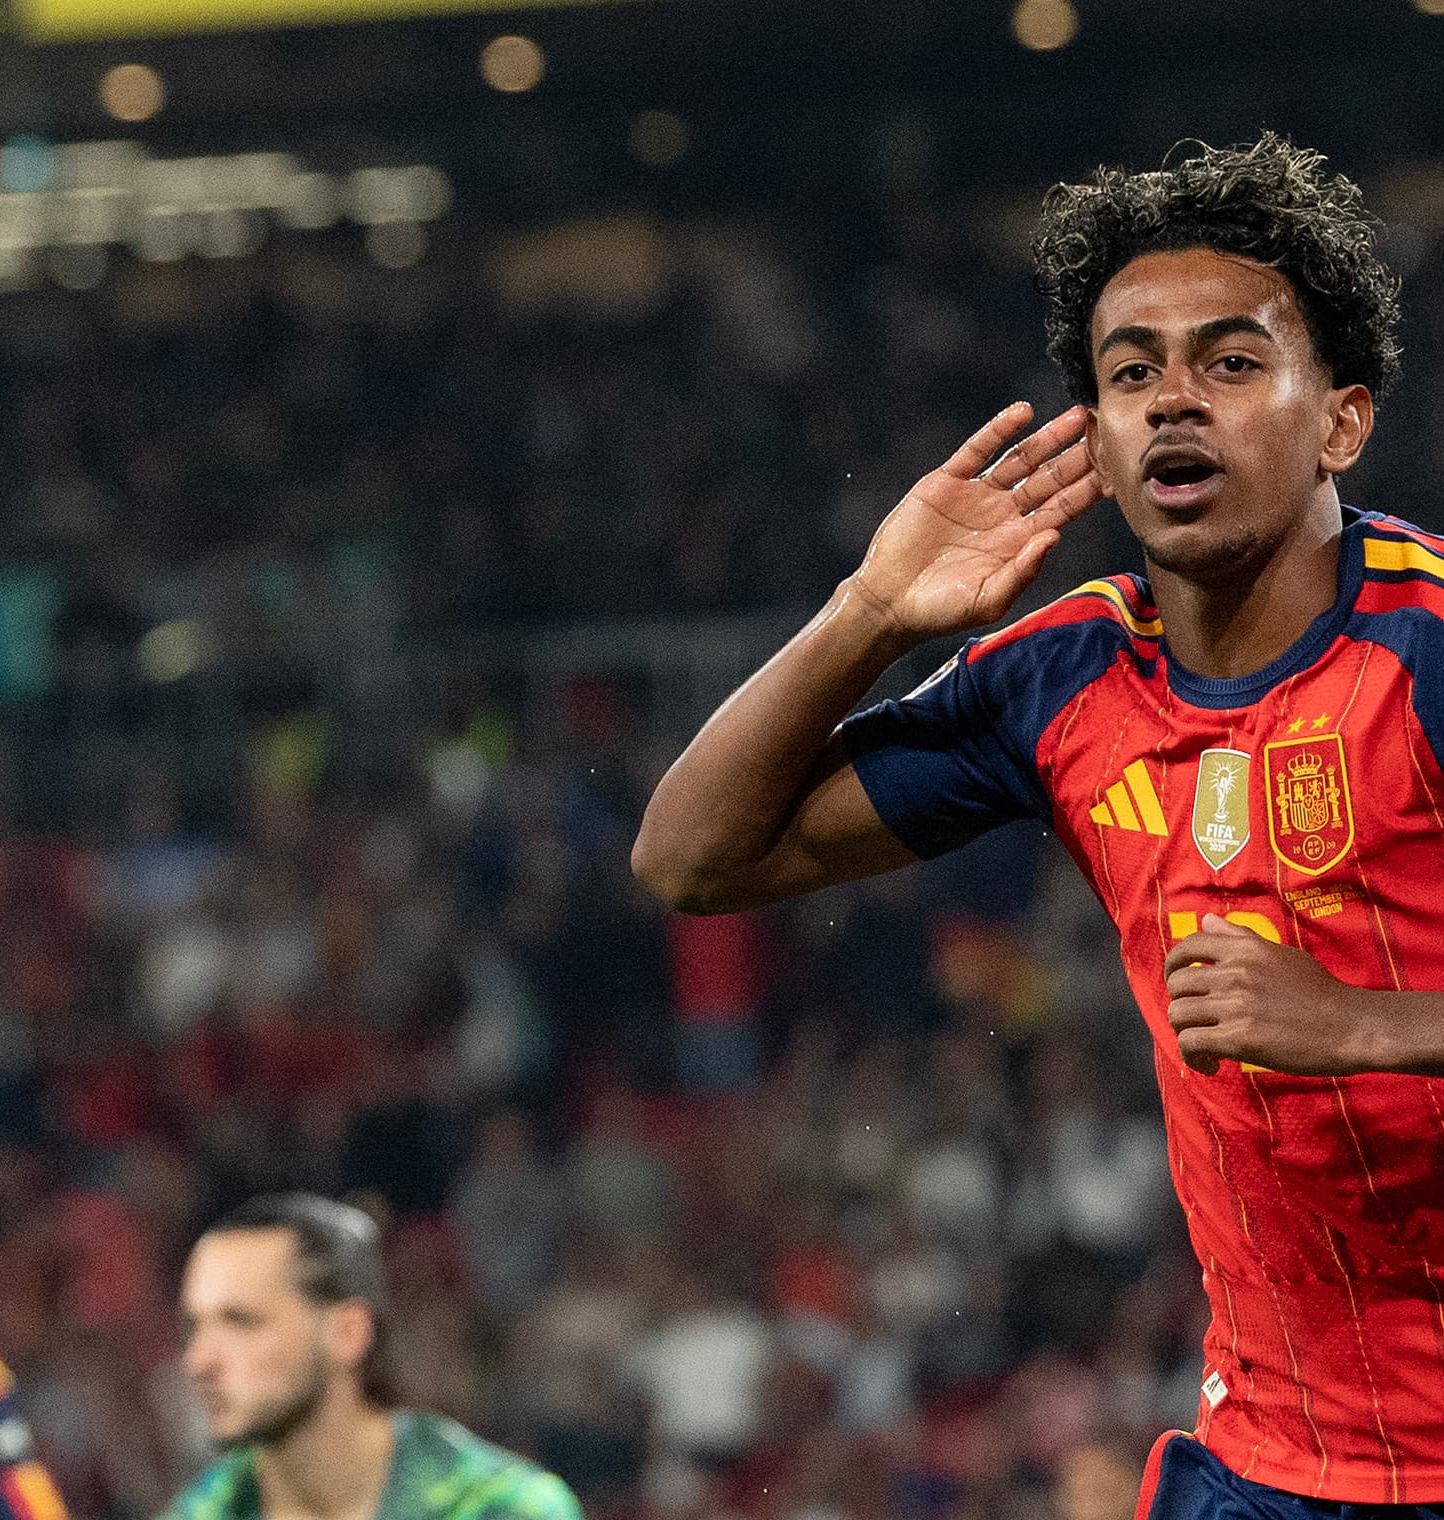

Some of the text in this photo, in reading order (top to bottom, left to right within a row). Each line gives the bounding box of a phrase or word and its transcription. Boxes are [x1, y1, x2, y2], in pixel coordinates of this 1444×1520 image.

[1206, 822, 1234, 840] FIFA
[1293, 892, 1344, 911] SEPTEMBER
[1309, 902, 1343, 919] LONDON
